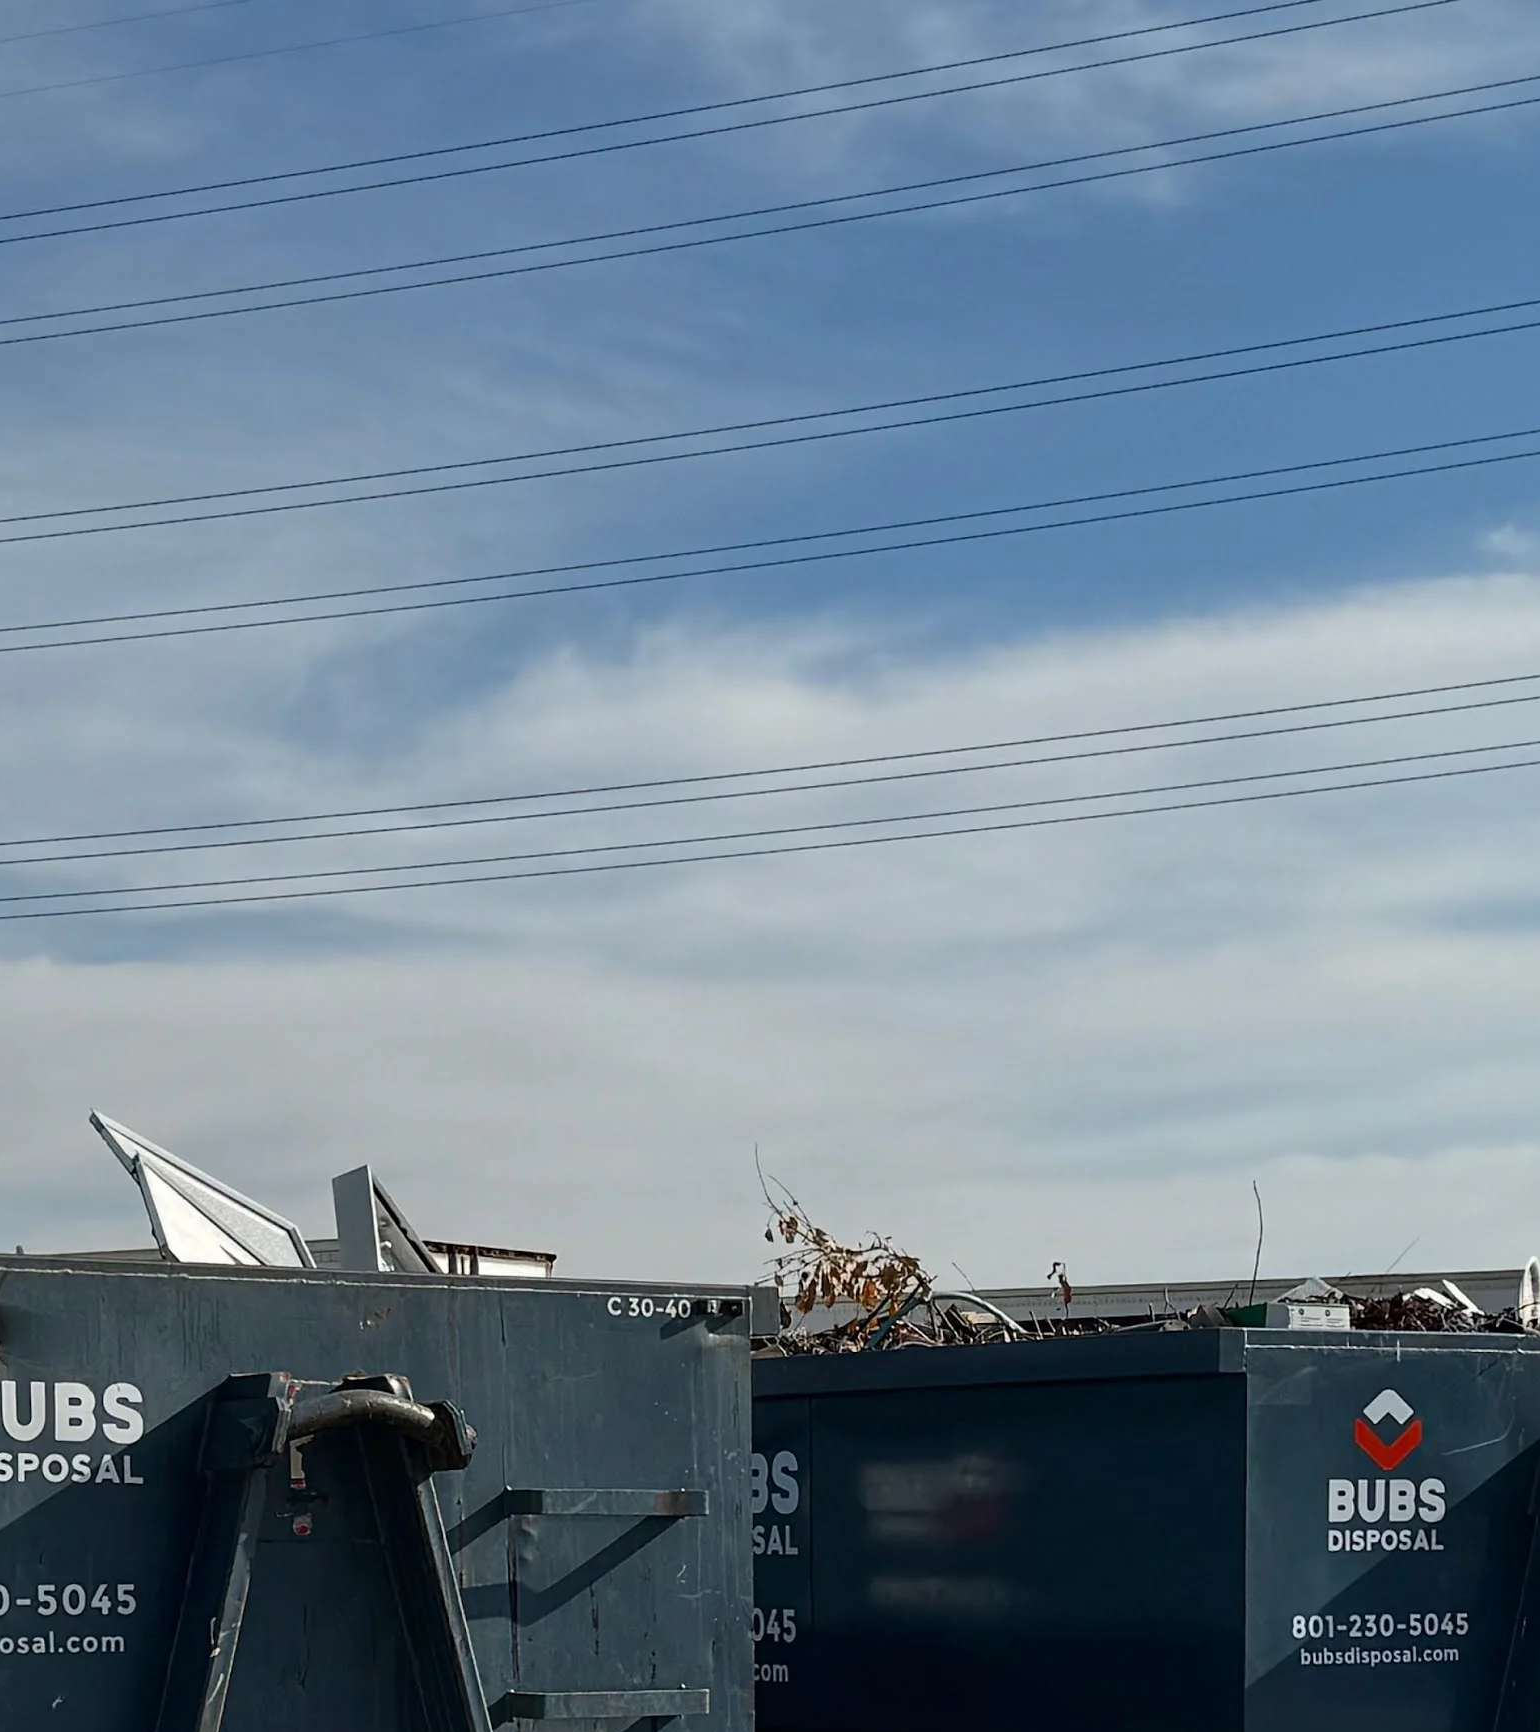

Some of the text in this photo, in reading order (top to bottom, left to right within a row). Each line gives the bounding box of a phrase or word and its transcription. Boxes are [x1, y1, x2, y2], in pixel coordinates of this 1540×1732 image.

[607, 1297, 691, 1318] C 30-40
[1328, 1478, 1446, 1523] BUBS
[1327, 1528, 1444, 1552] DISPOSAL
[1292, 1613, 1469, 1639] 801-230-5045
[1300, 1646, 1459, 1667] bubsdisposal.com
